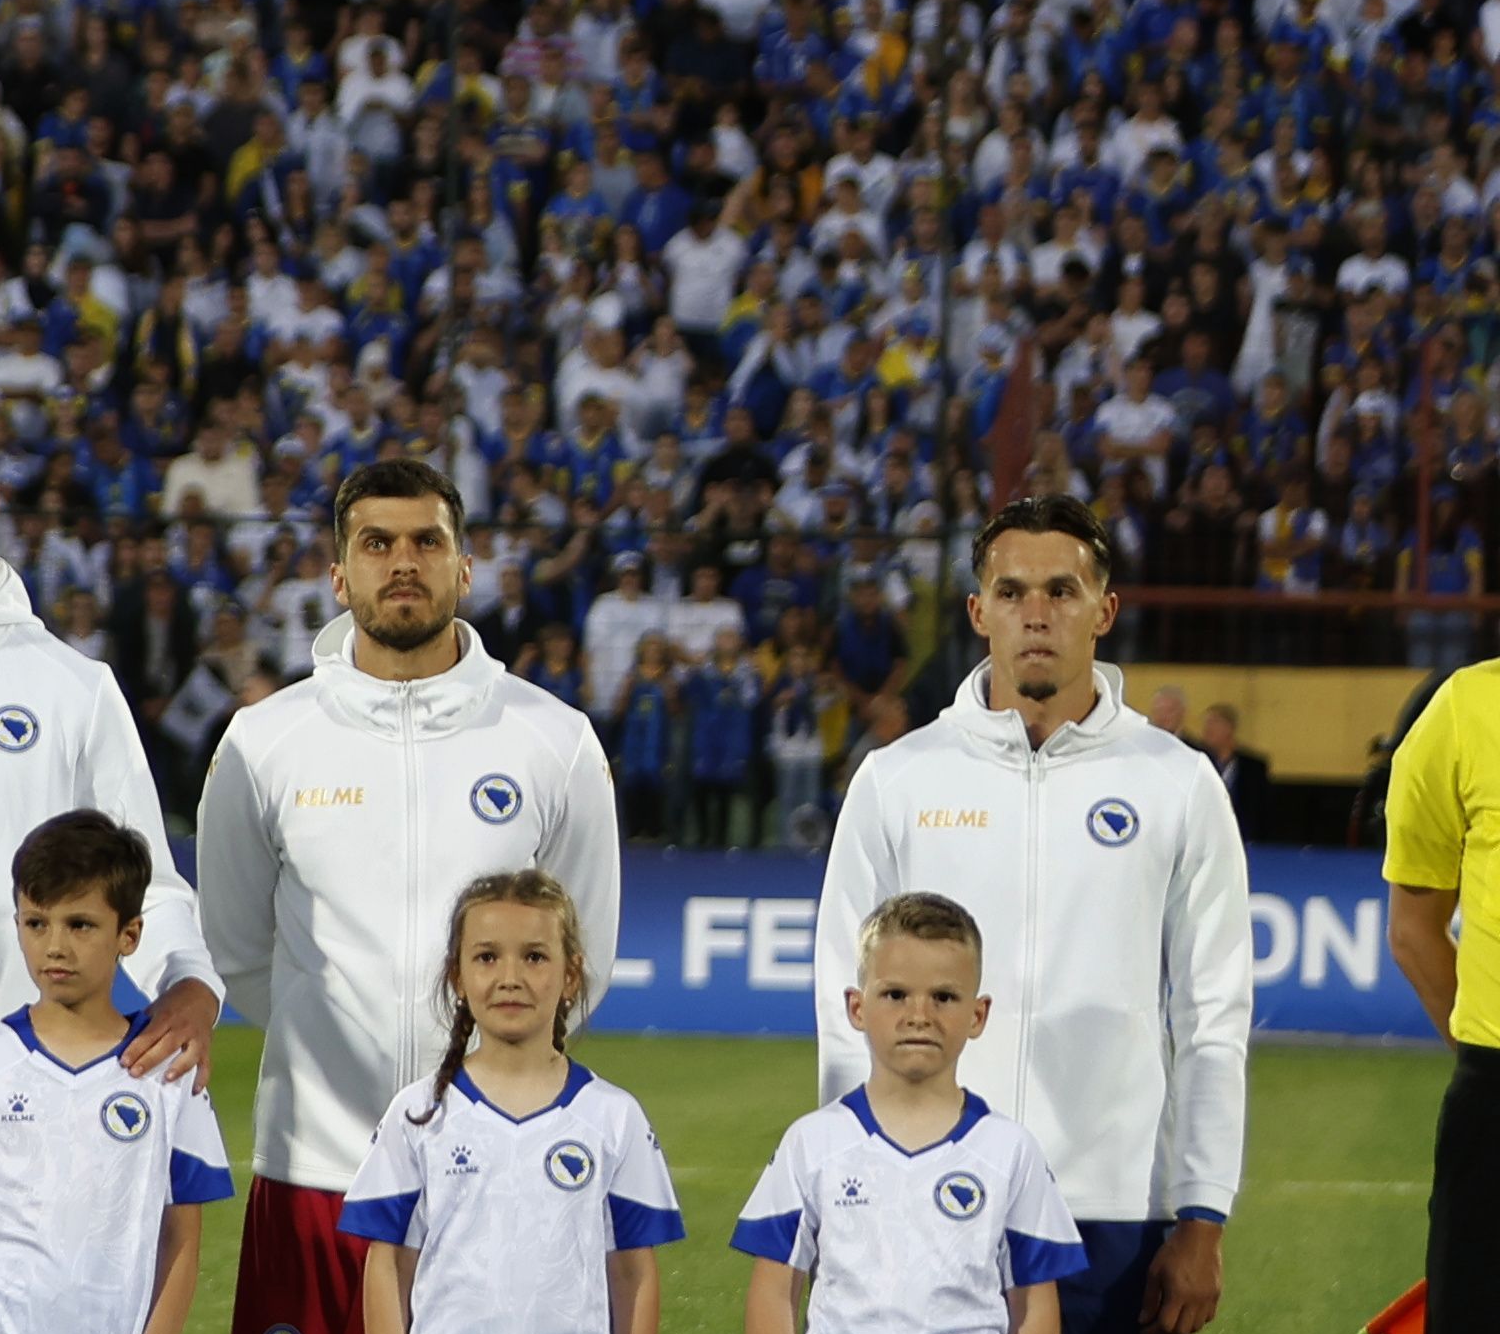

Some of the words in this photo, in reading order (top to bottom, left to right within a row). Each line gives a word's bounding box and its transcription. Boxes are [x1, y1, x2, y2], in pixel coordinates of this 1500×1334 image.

[295, 787, 364, 807] KELME
[917, 809, 989, 828] KELME
[1, 1113, 35, 1123] KELME
[835, 1196, 870, 1207] KELME
